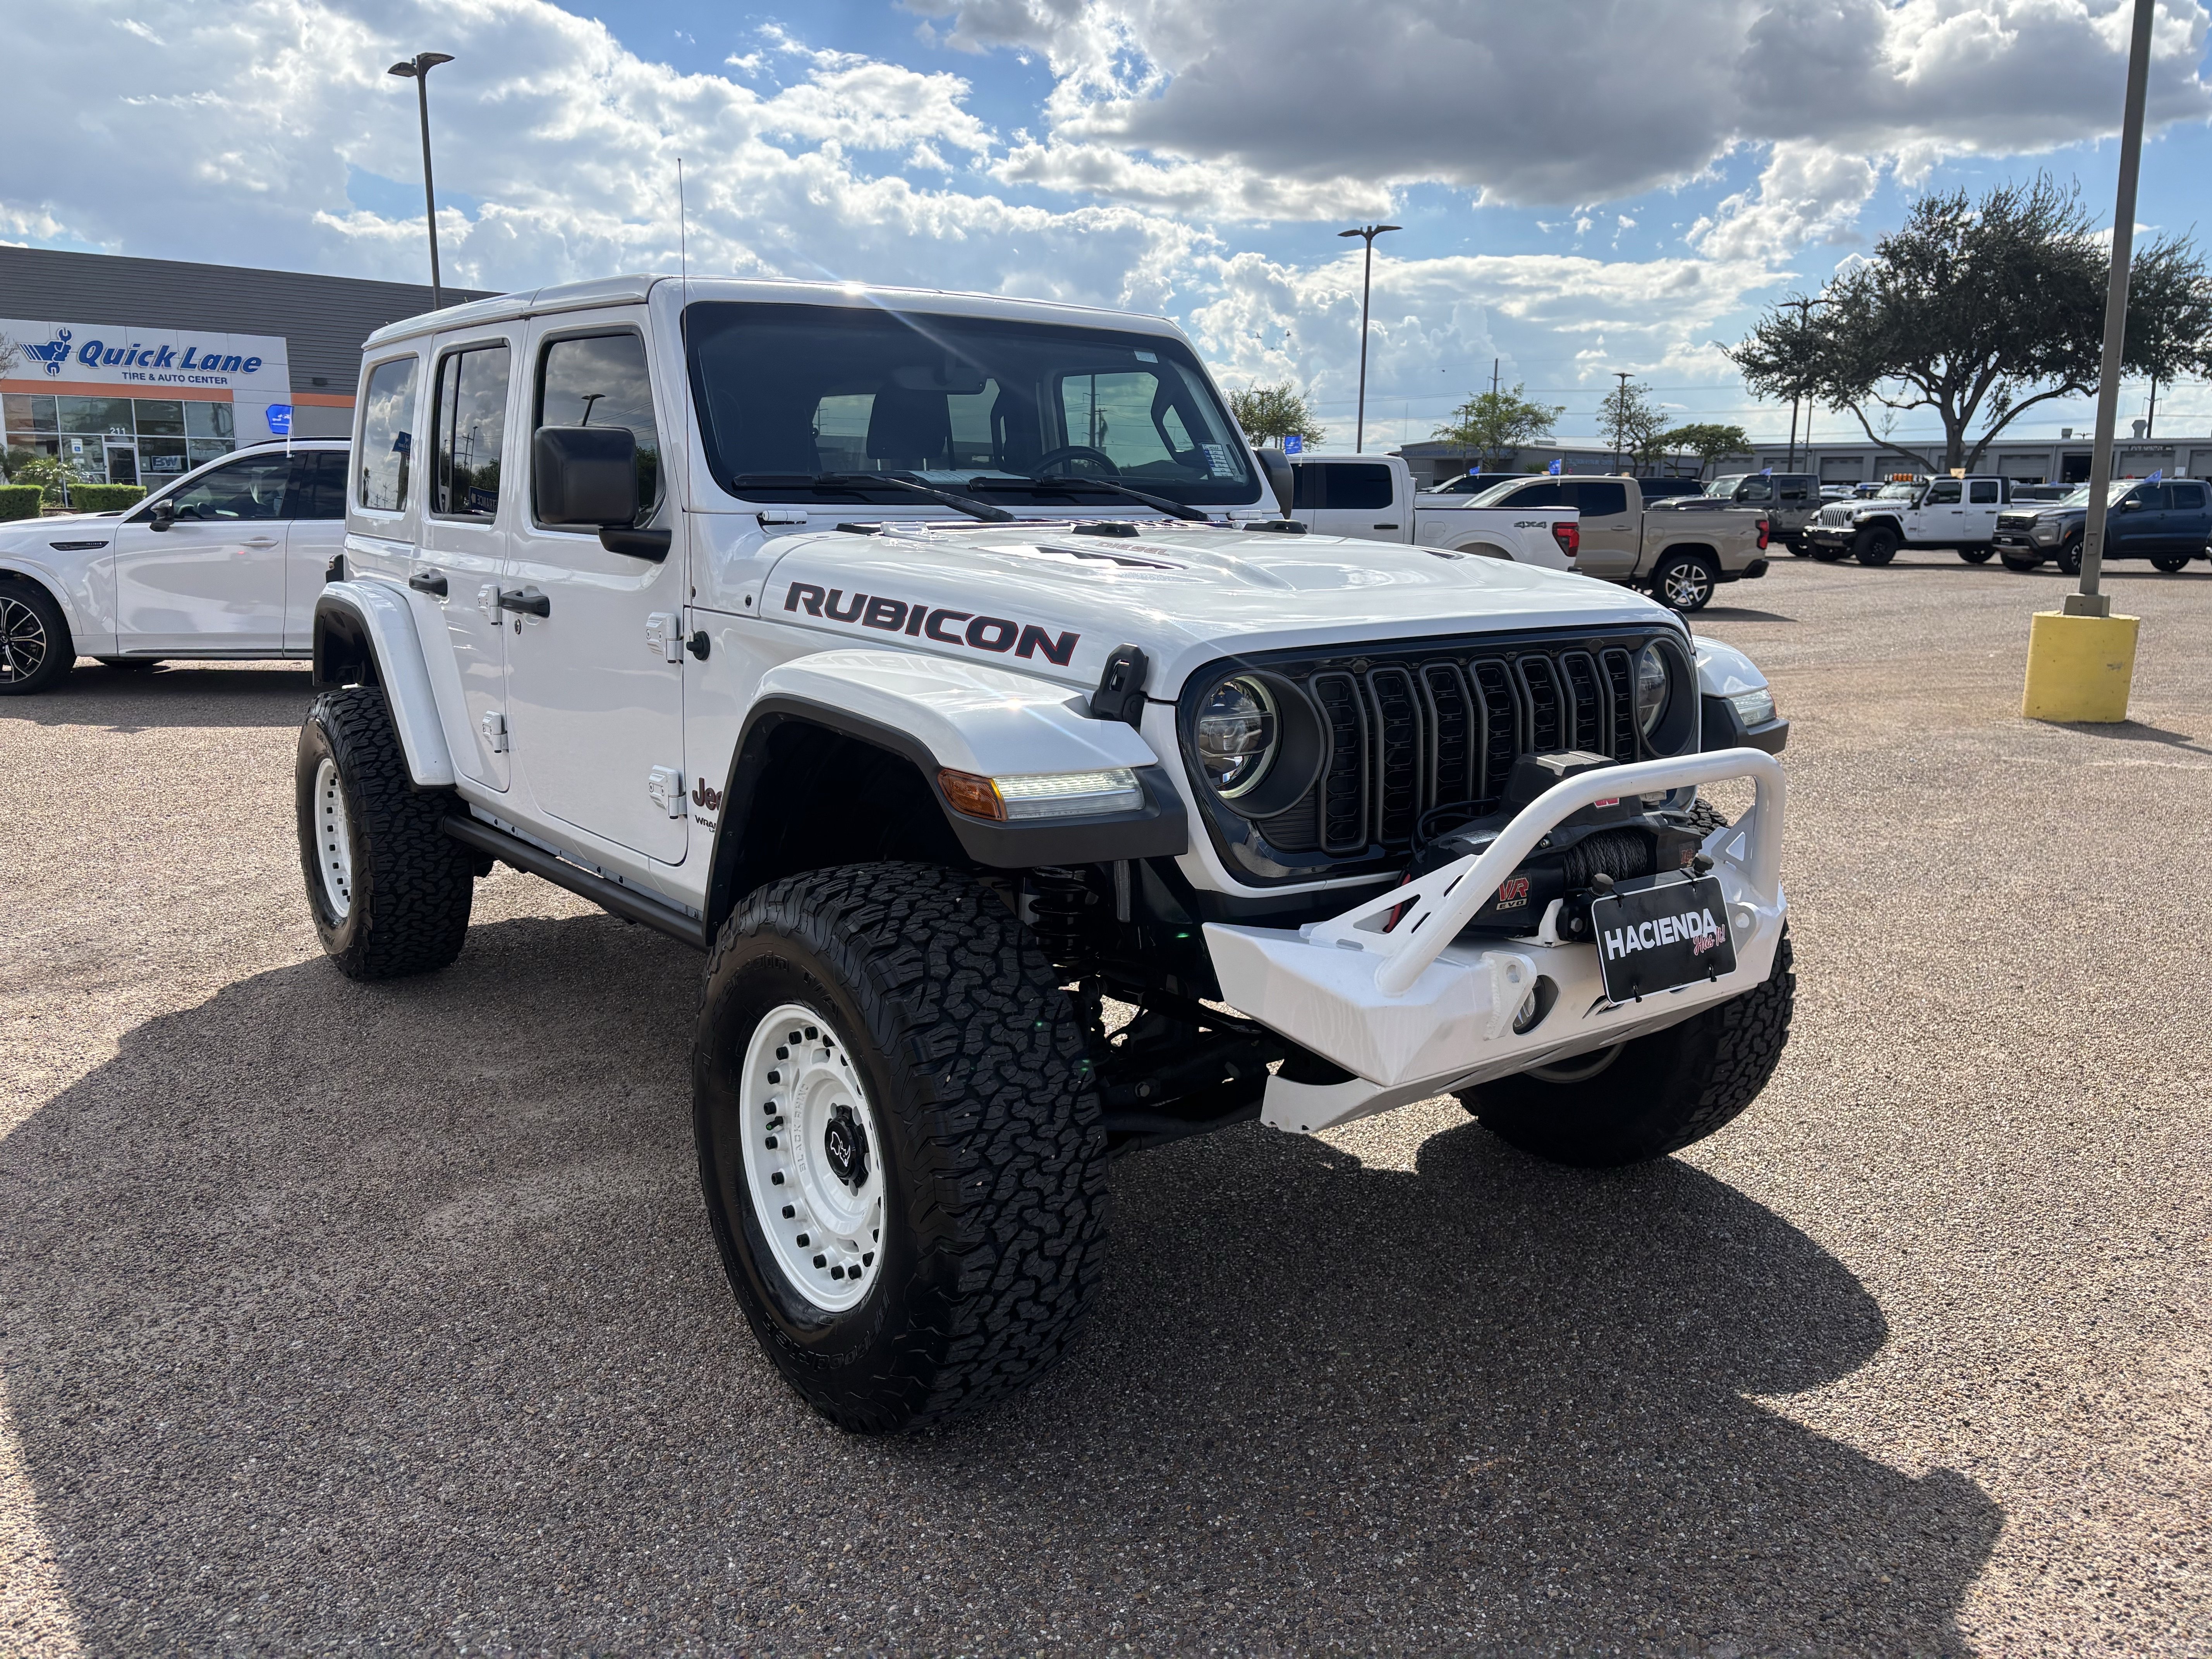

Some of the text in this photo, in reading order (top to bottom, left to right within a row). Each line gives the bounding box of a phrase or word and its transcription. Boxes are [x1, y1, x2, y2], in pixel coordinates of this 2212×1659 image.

[77, 340, 262, 373] Quick Lane
[122, 372, 146, 380] TIRE
[158, 374, 185, 382] AUTO
[188, 376, 228, 384] CENTER
[1095, 541, 1170, 556] DIESEL
[783, 581, 1081, 667] RUBICON
[1499, 900, 1523, 909] EVO
[1604, 908, 1717, 960] HACIENDA
[1693, 924, 1726, 956] Has It!
[793, 1124, 806, 1173] BLACK
